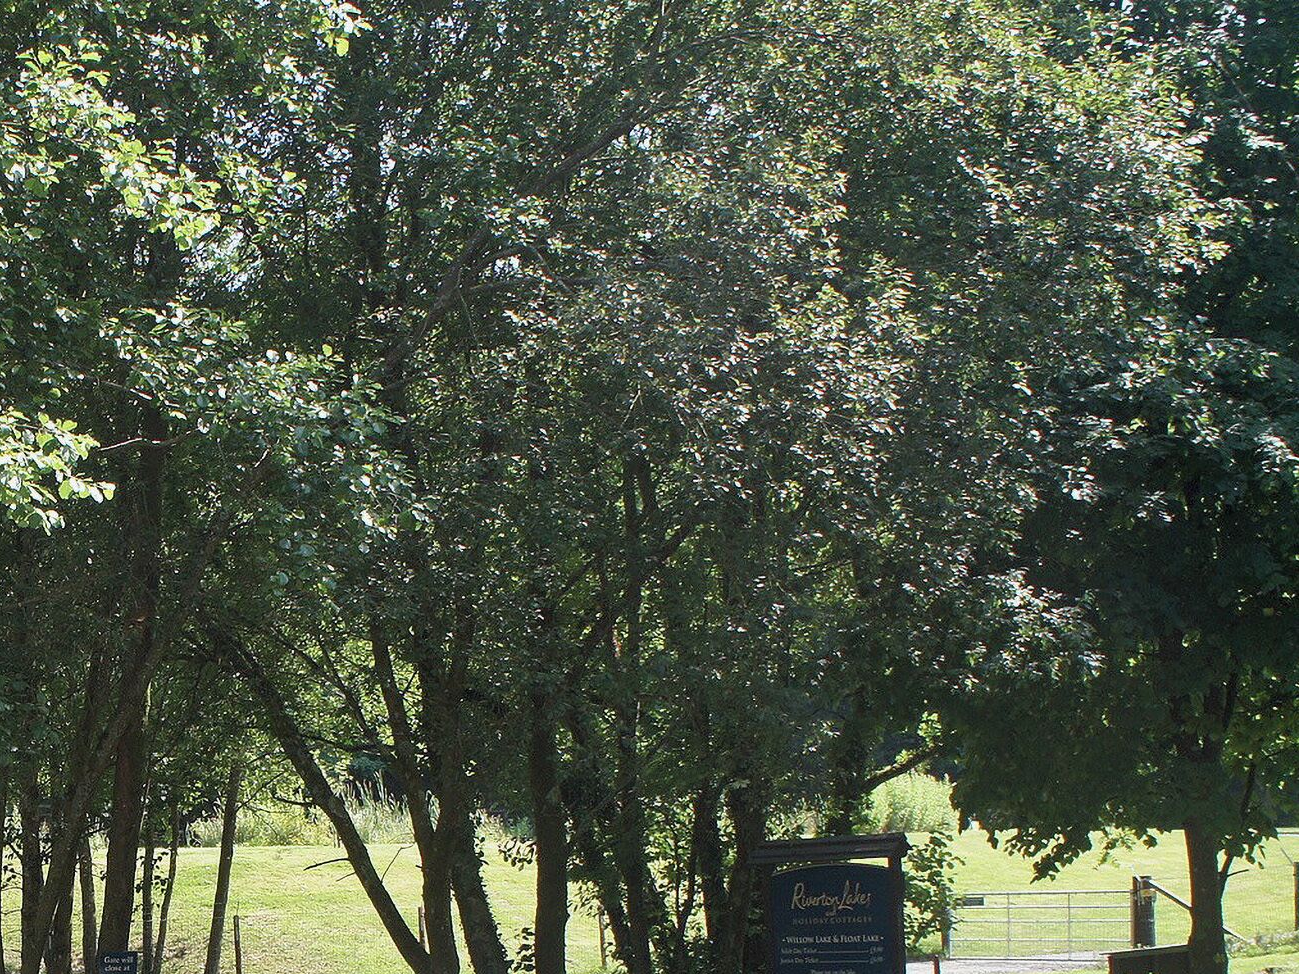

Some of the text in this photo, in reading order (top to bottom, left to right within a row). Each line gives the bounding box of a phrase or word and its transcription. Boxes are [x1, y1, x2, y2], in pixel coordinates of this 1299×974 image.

[791, 880, 872, 910] Riverton Lakes
[862, 934, 880, 942] LAKE
